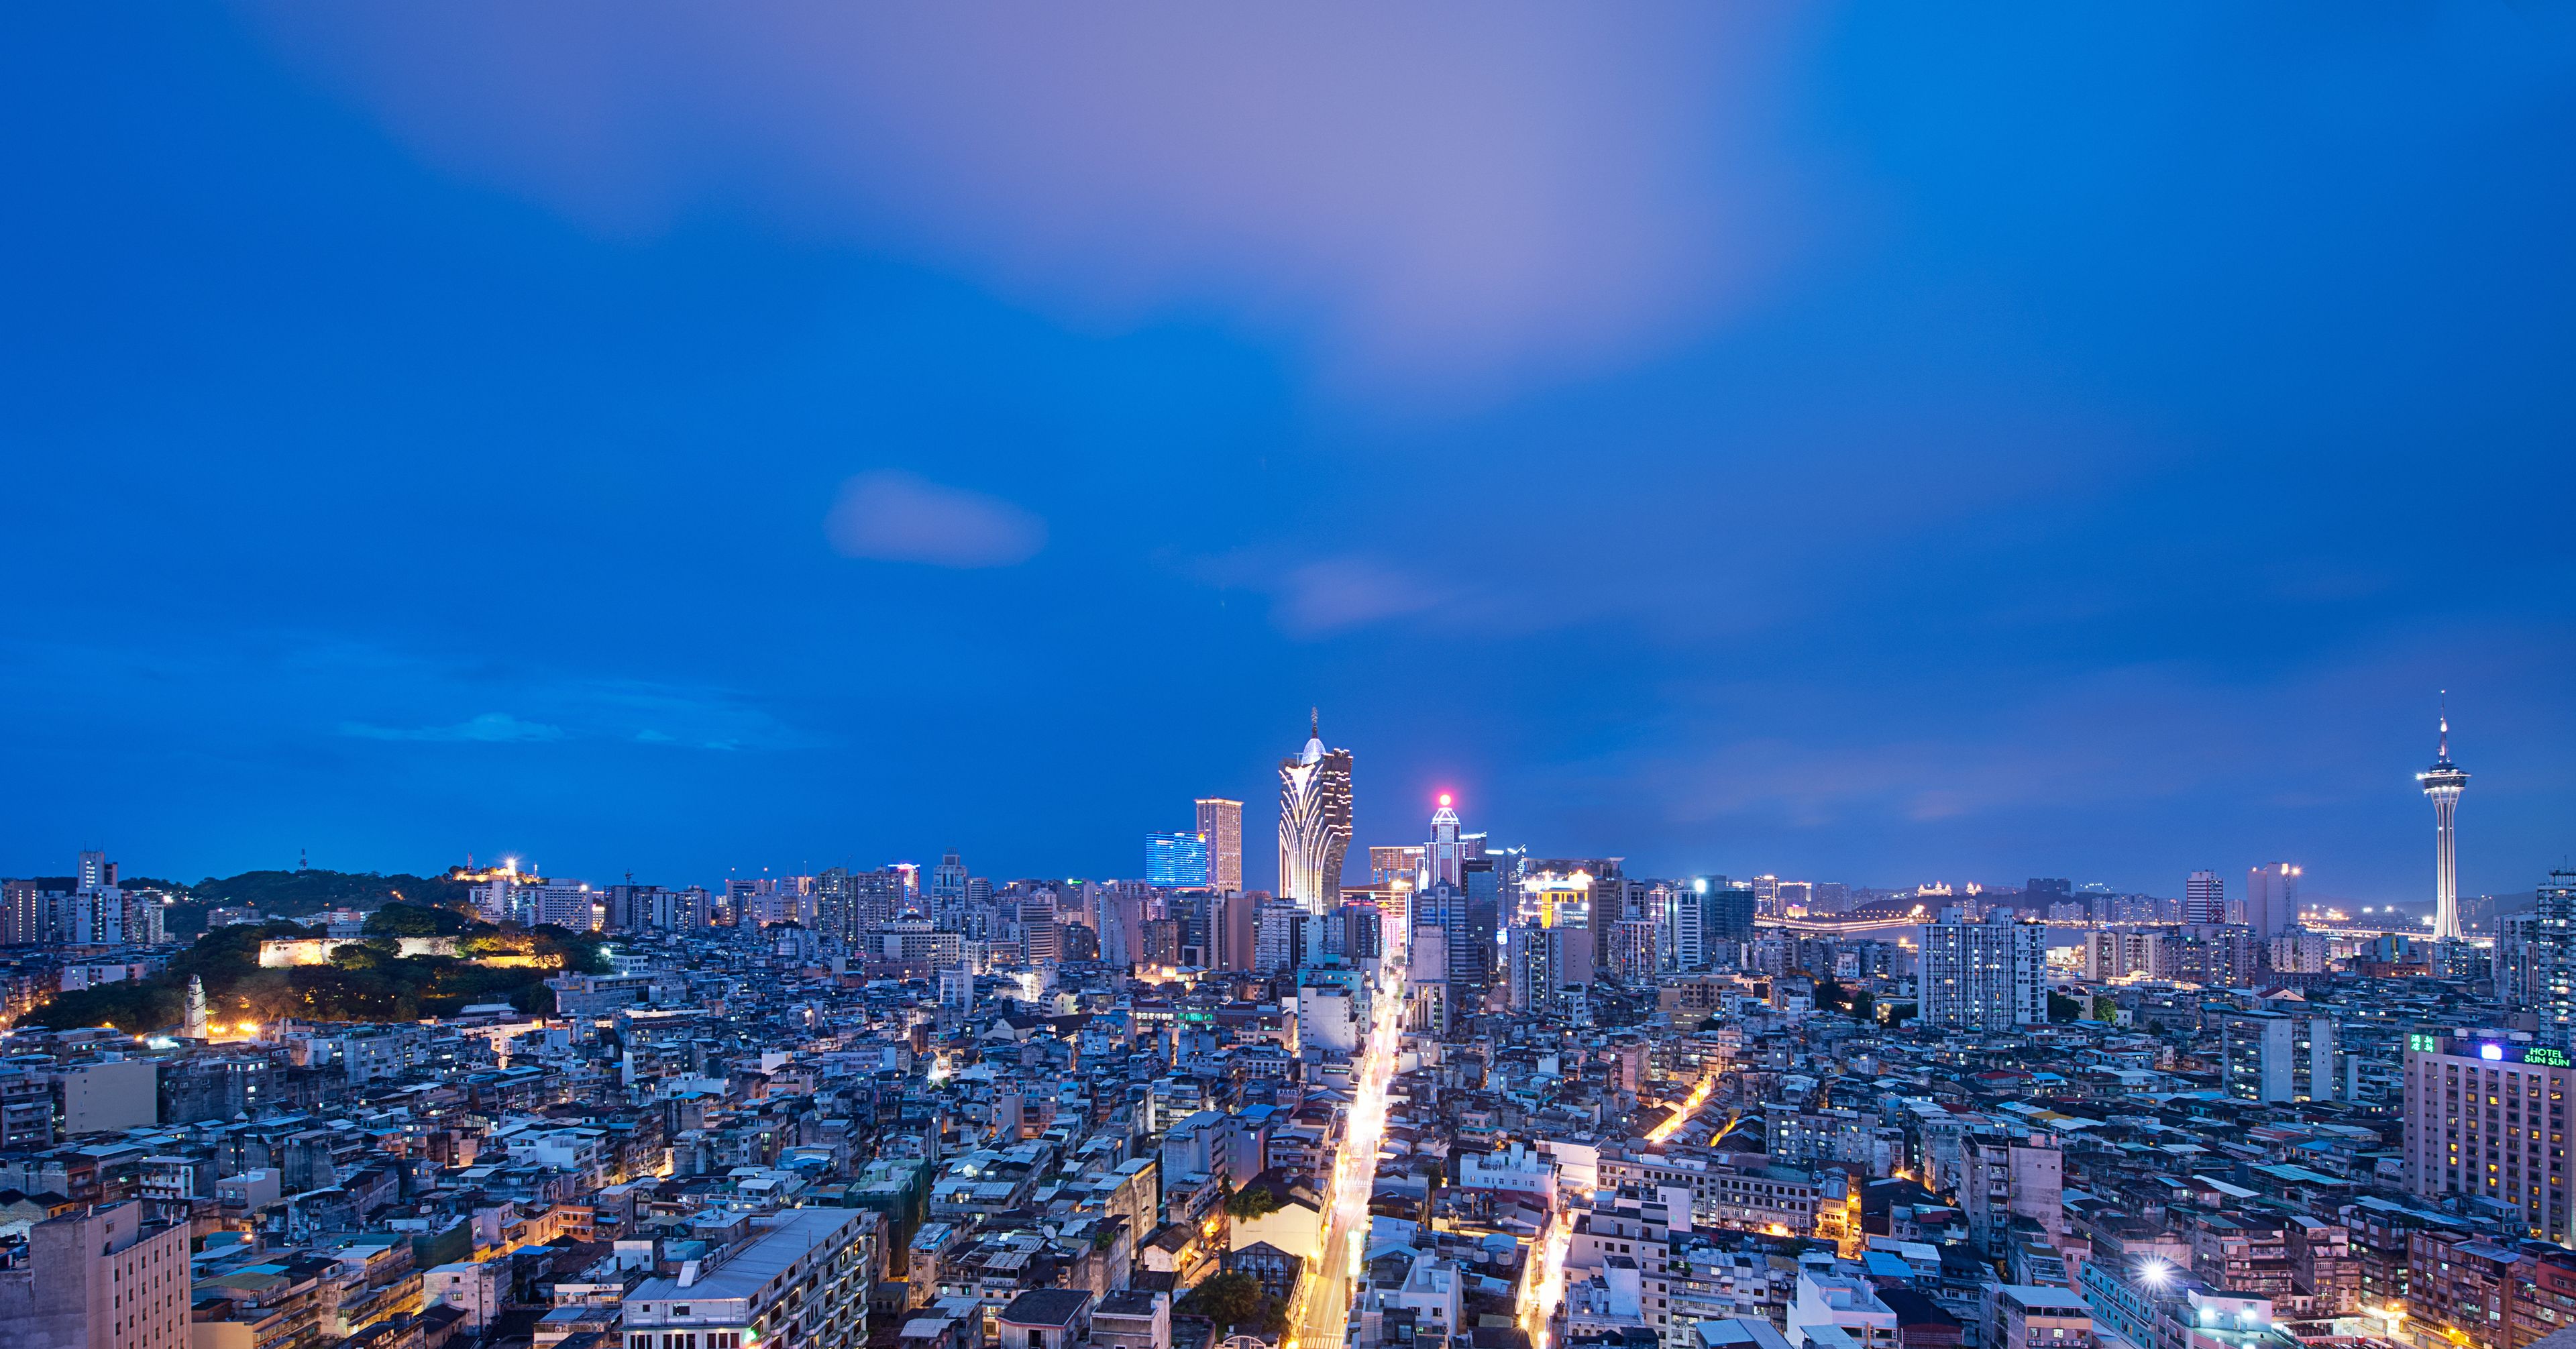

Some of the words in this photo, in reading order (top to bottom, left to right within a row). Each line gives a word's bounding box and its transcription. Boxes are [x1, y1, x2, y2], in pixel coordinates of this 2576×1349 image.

[2530, 1047, 2563, 1059] HOTEL
[2524, 1055, 2546, 1064] SUN
[2548, 1057, 2570, 1067] SUN
